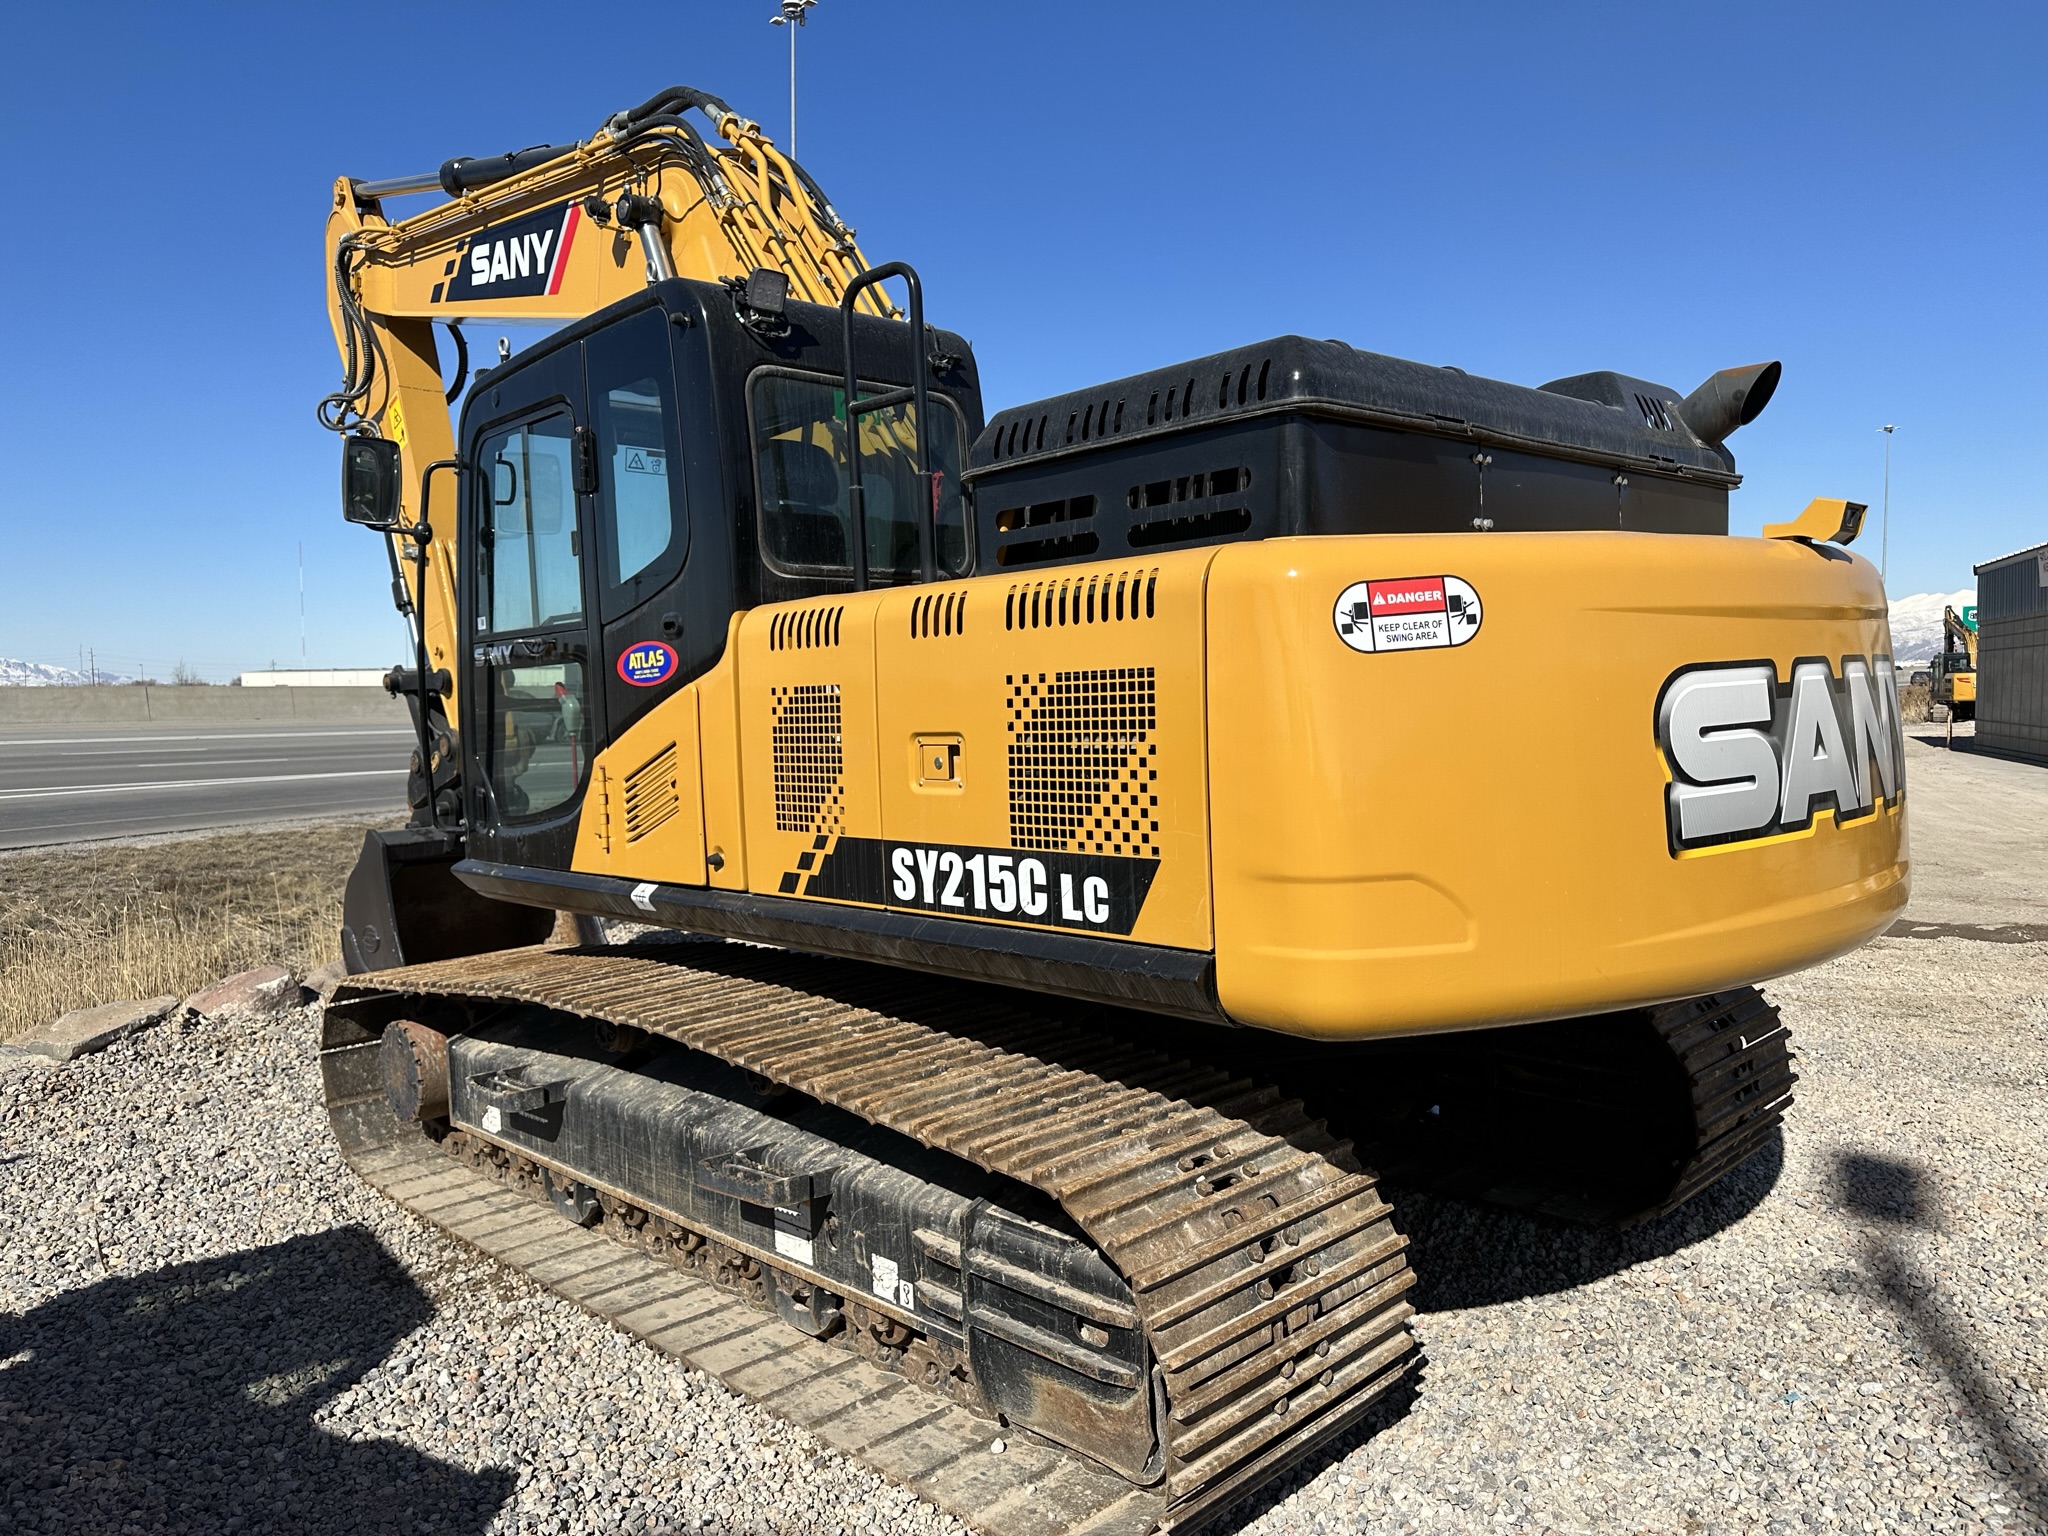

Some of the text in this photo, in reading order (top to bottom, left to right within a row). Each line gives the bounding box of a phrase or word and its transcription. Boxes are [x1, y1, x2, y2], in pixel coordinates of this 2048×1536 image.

[471, 229, 554, 286] SANY
[1387, 590, 1442, 605] DANGER
[1378, 620, 1443, 632] KEEP CLEAR OF
[1386, 631, 1438, 643] SWING AREA
[629, 649, 665, 670] ATLAS
[892, 847, 1109, 923] SY215C LC
